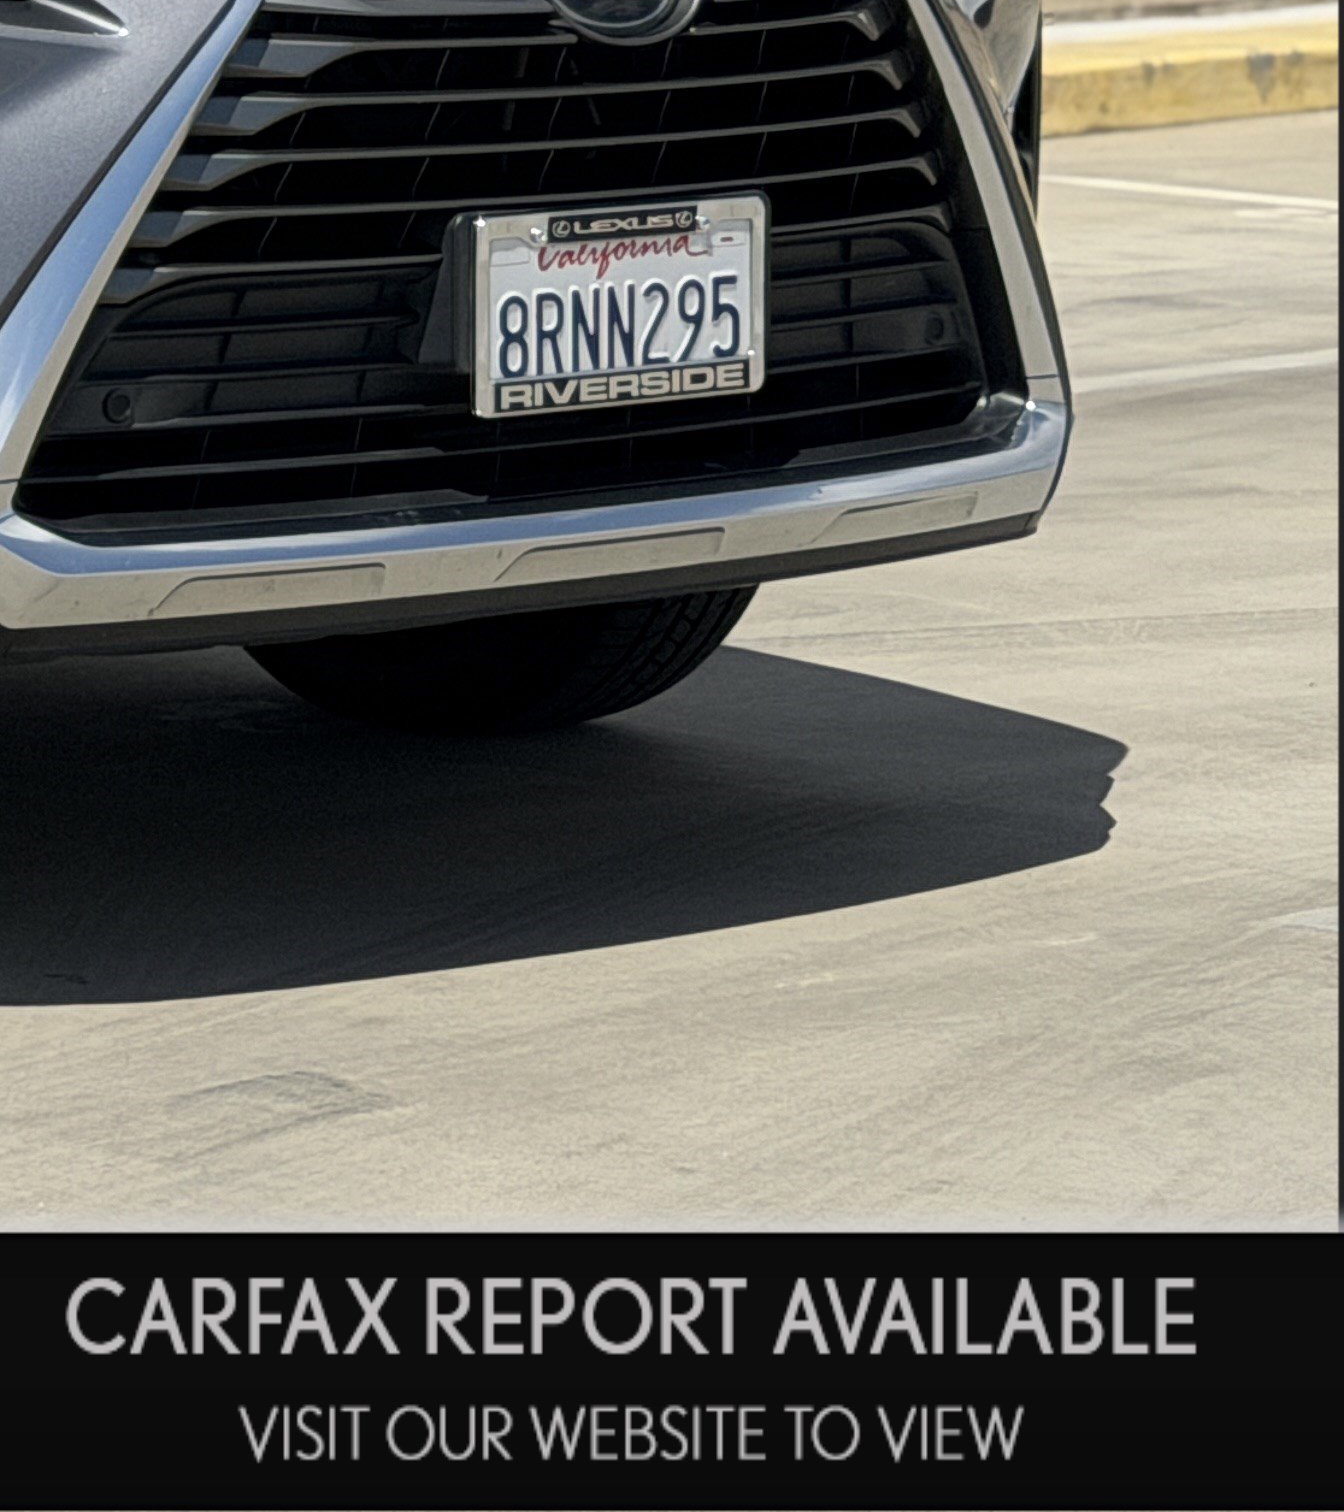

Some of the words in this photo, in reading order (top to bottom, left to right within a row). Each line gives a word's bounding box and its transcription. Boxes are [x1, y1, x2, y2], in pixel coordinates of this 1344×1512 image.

[572, 214, 674, 236] LEXUS
[496, 269, 741, 379] 8RNN295
[500, 362, 746, 411] RIVERSIDE
